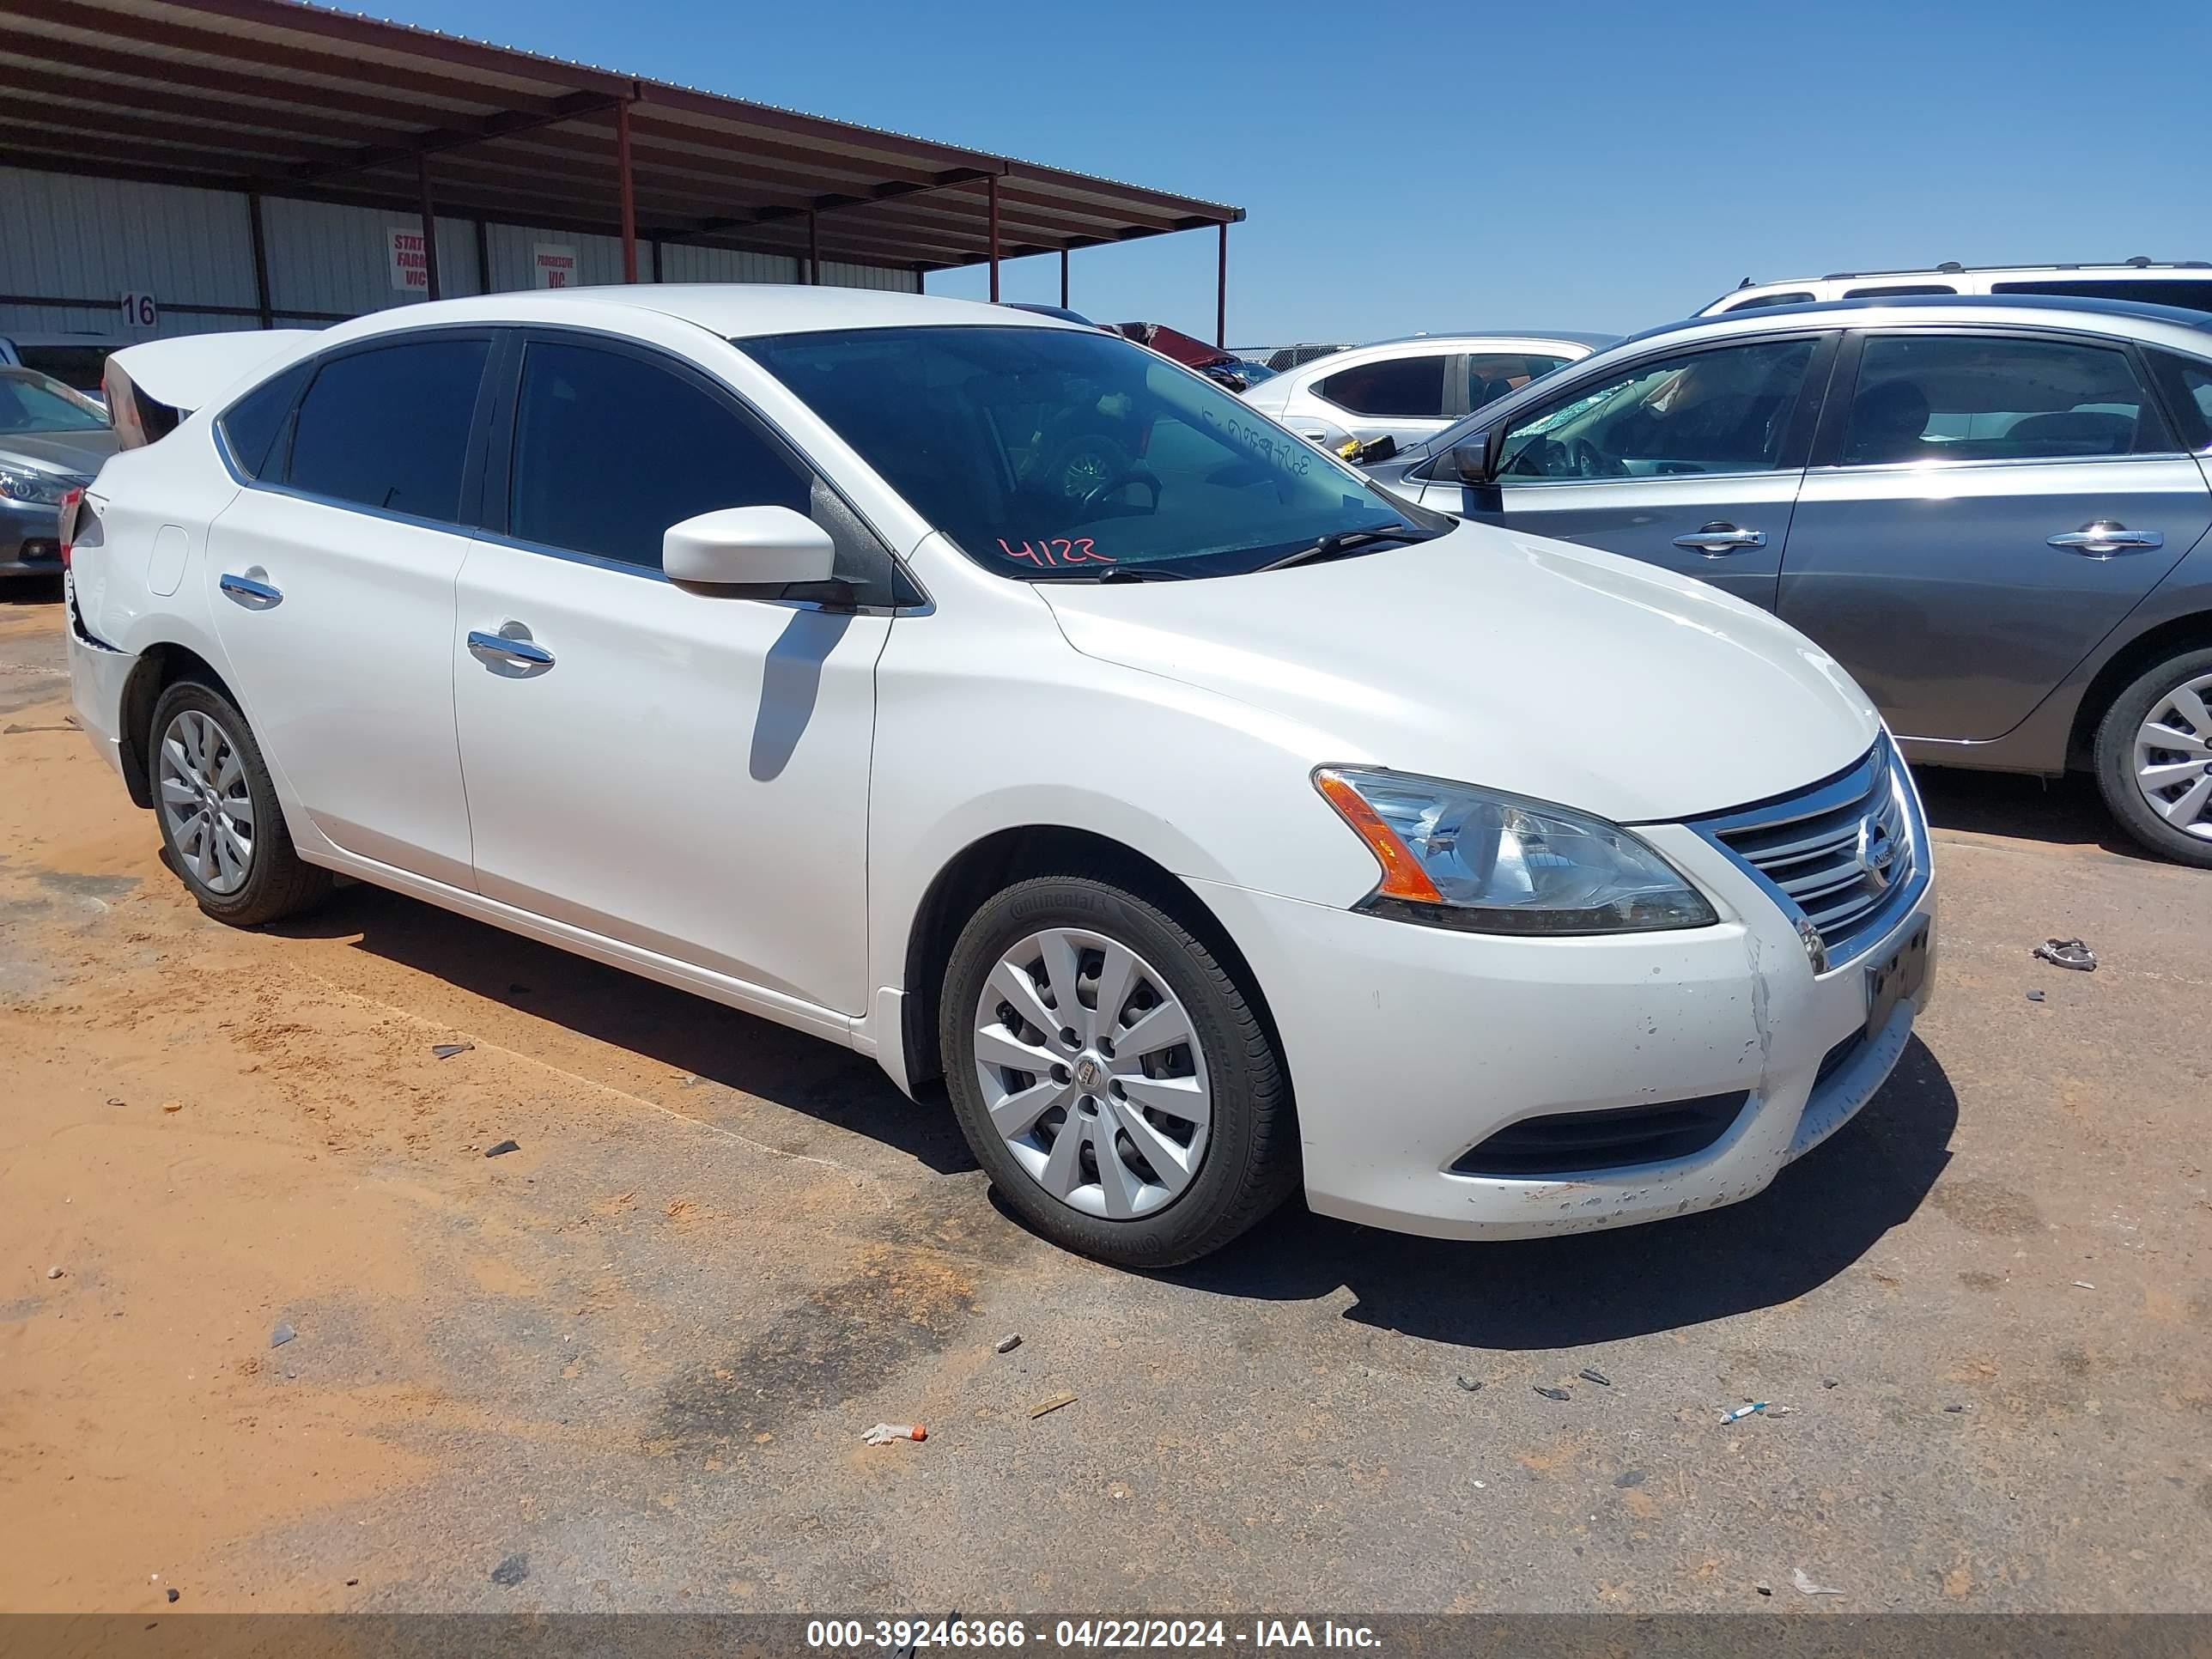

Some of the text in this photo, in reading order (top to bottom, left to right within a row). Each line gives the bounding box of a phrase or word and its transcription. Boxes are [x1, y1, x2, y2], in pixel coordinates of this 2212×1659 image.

[395, 234, 425, 251] STAT
[406, 270, 427, 286] VIC
[549, 270, 565, 288] VIC
[123, 294, 155, 325] 16
[997, 538, 1117, 567] 4122
[1010, 893, 1095, 921] Continental
